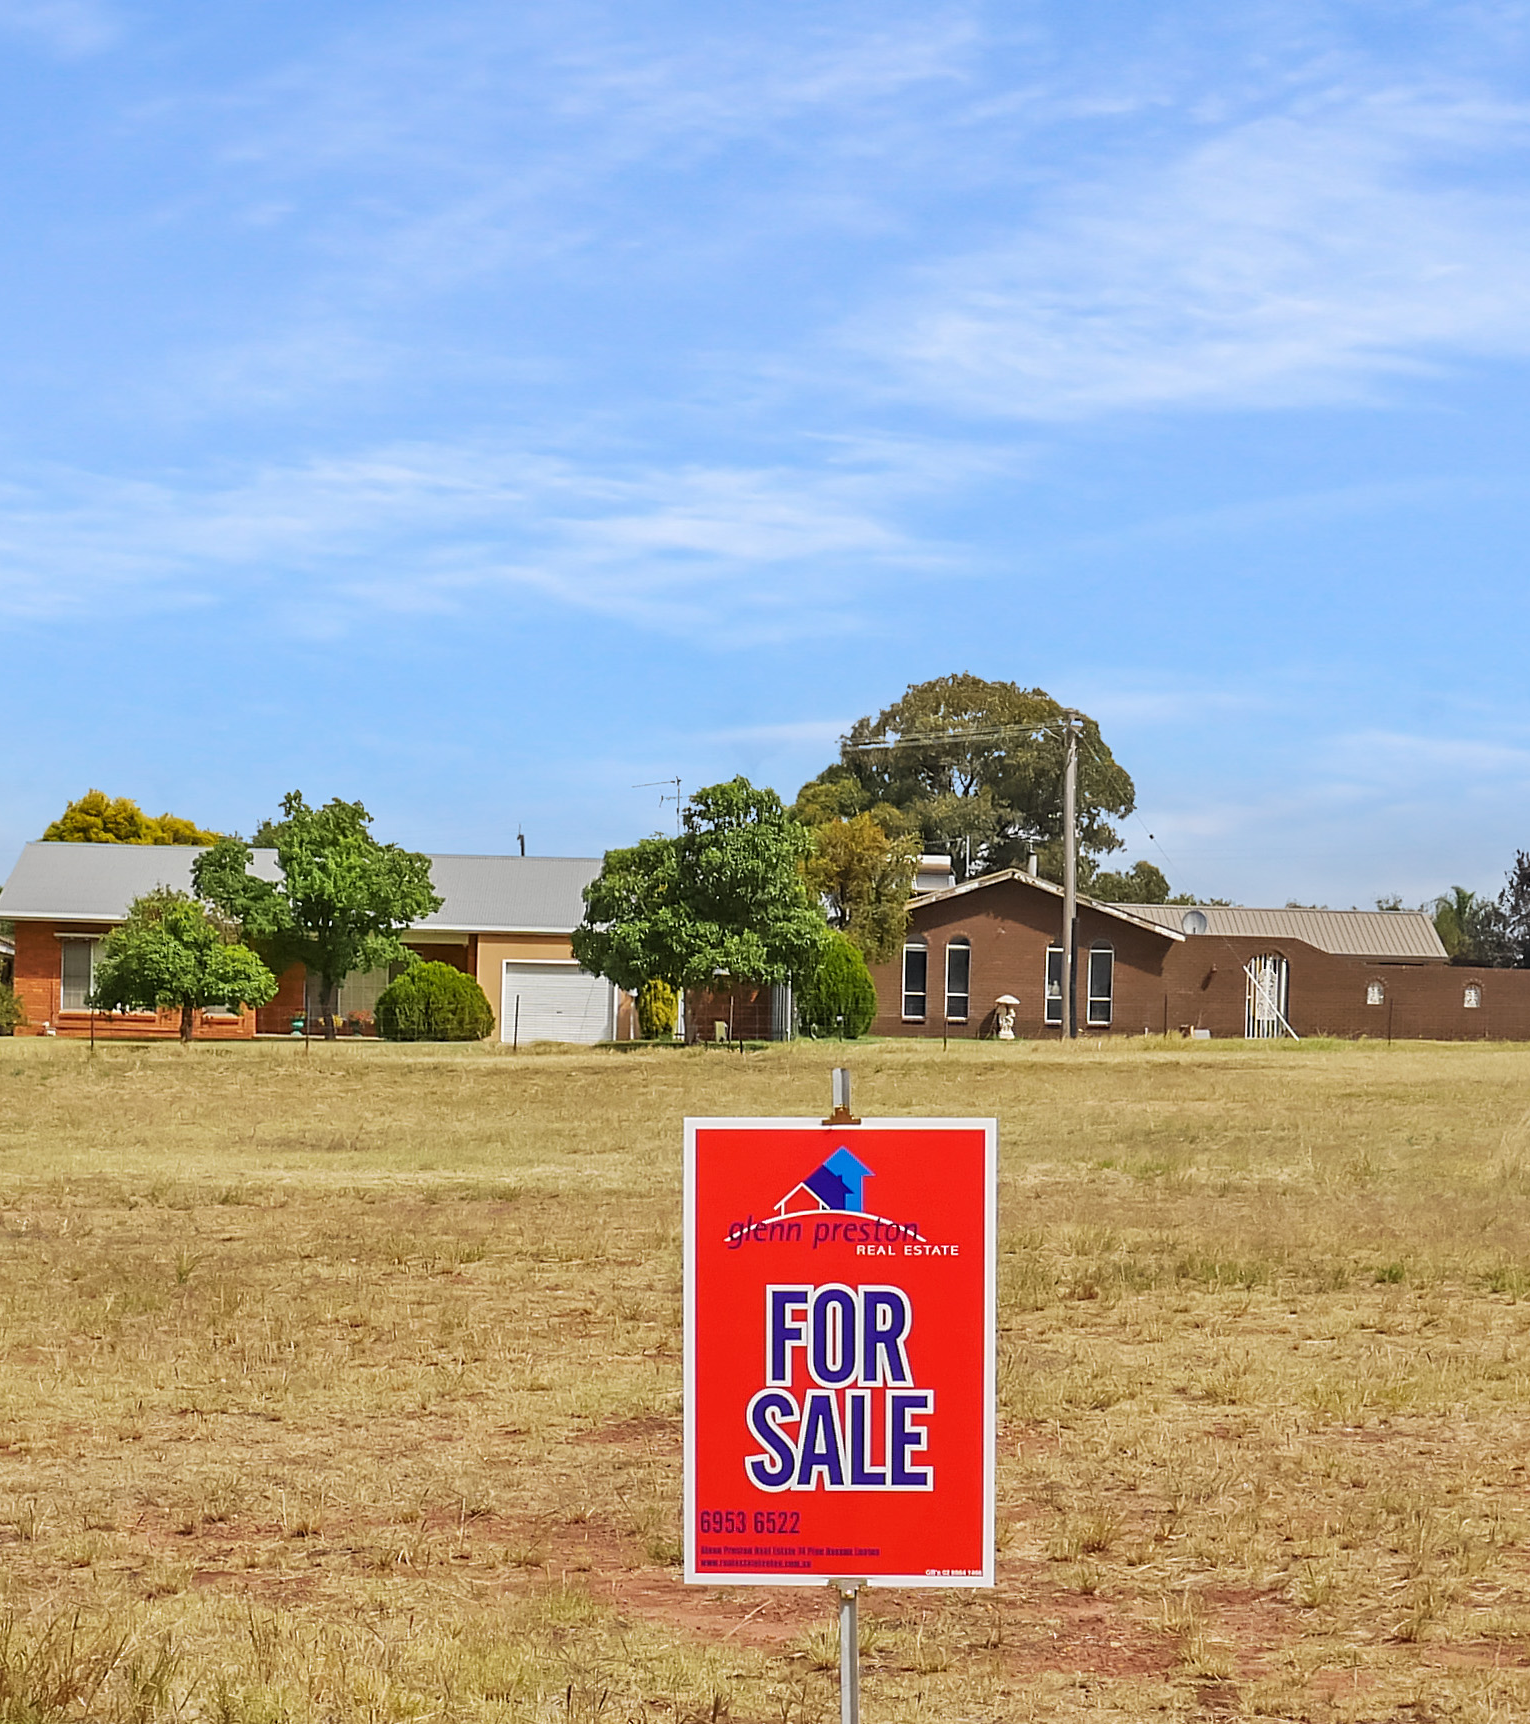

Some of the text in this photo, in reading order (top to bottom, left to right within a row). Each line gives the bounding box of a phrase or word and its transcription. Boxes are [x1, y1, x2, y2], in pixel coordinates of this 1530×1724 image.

[727, 1215, 919, 1250] glenn preston
[856, 1245, 959, 1256] REAL ESTATE
[766, 1283, 914, 1390] FOR
[744, 1388, 934, 1493] SALE
[700, 1510, 801, 1534] 6953 6522
